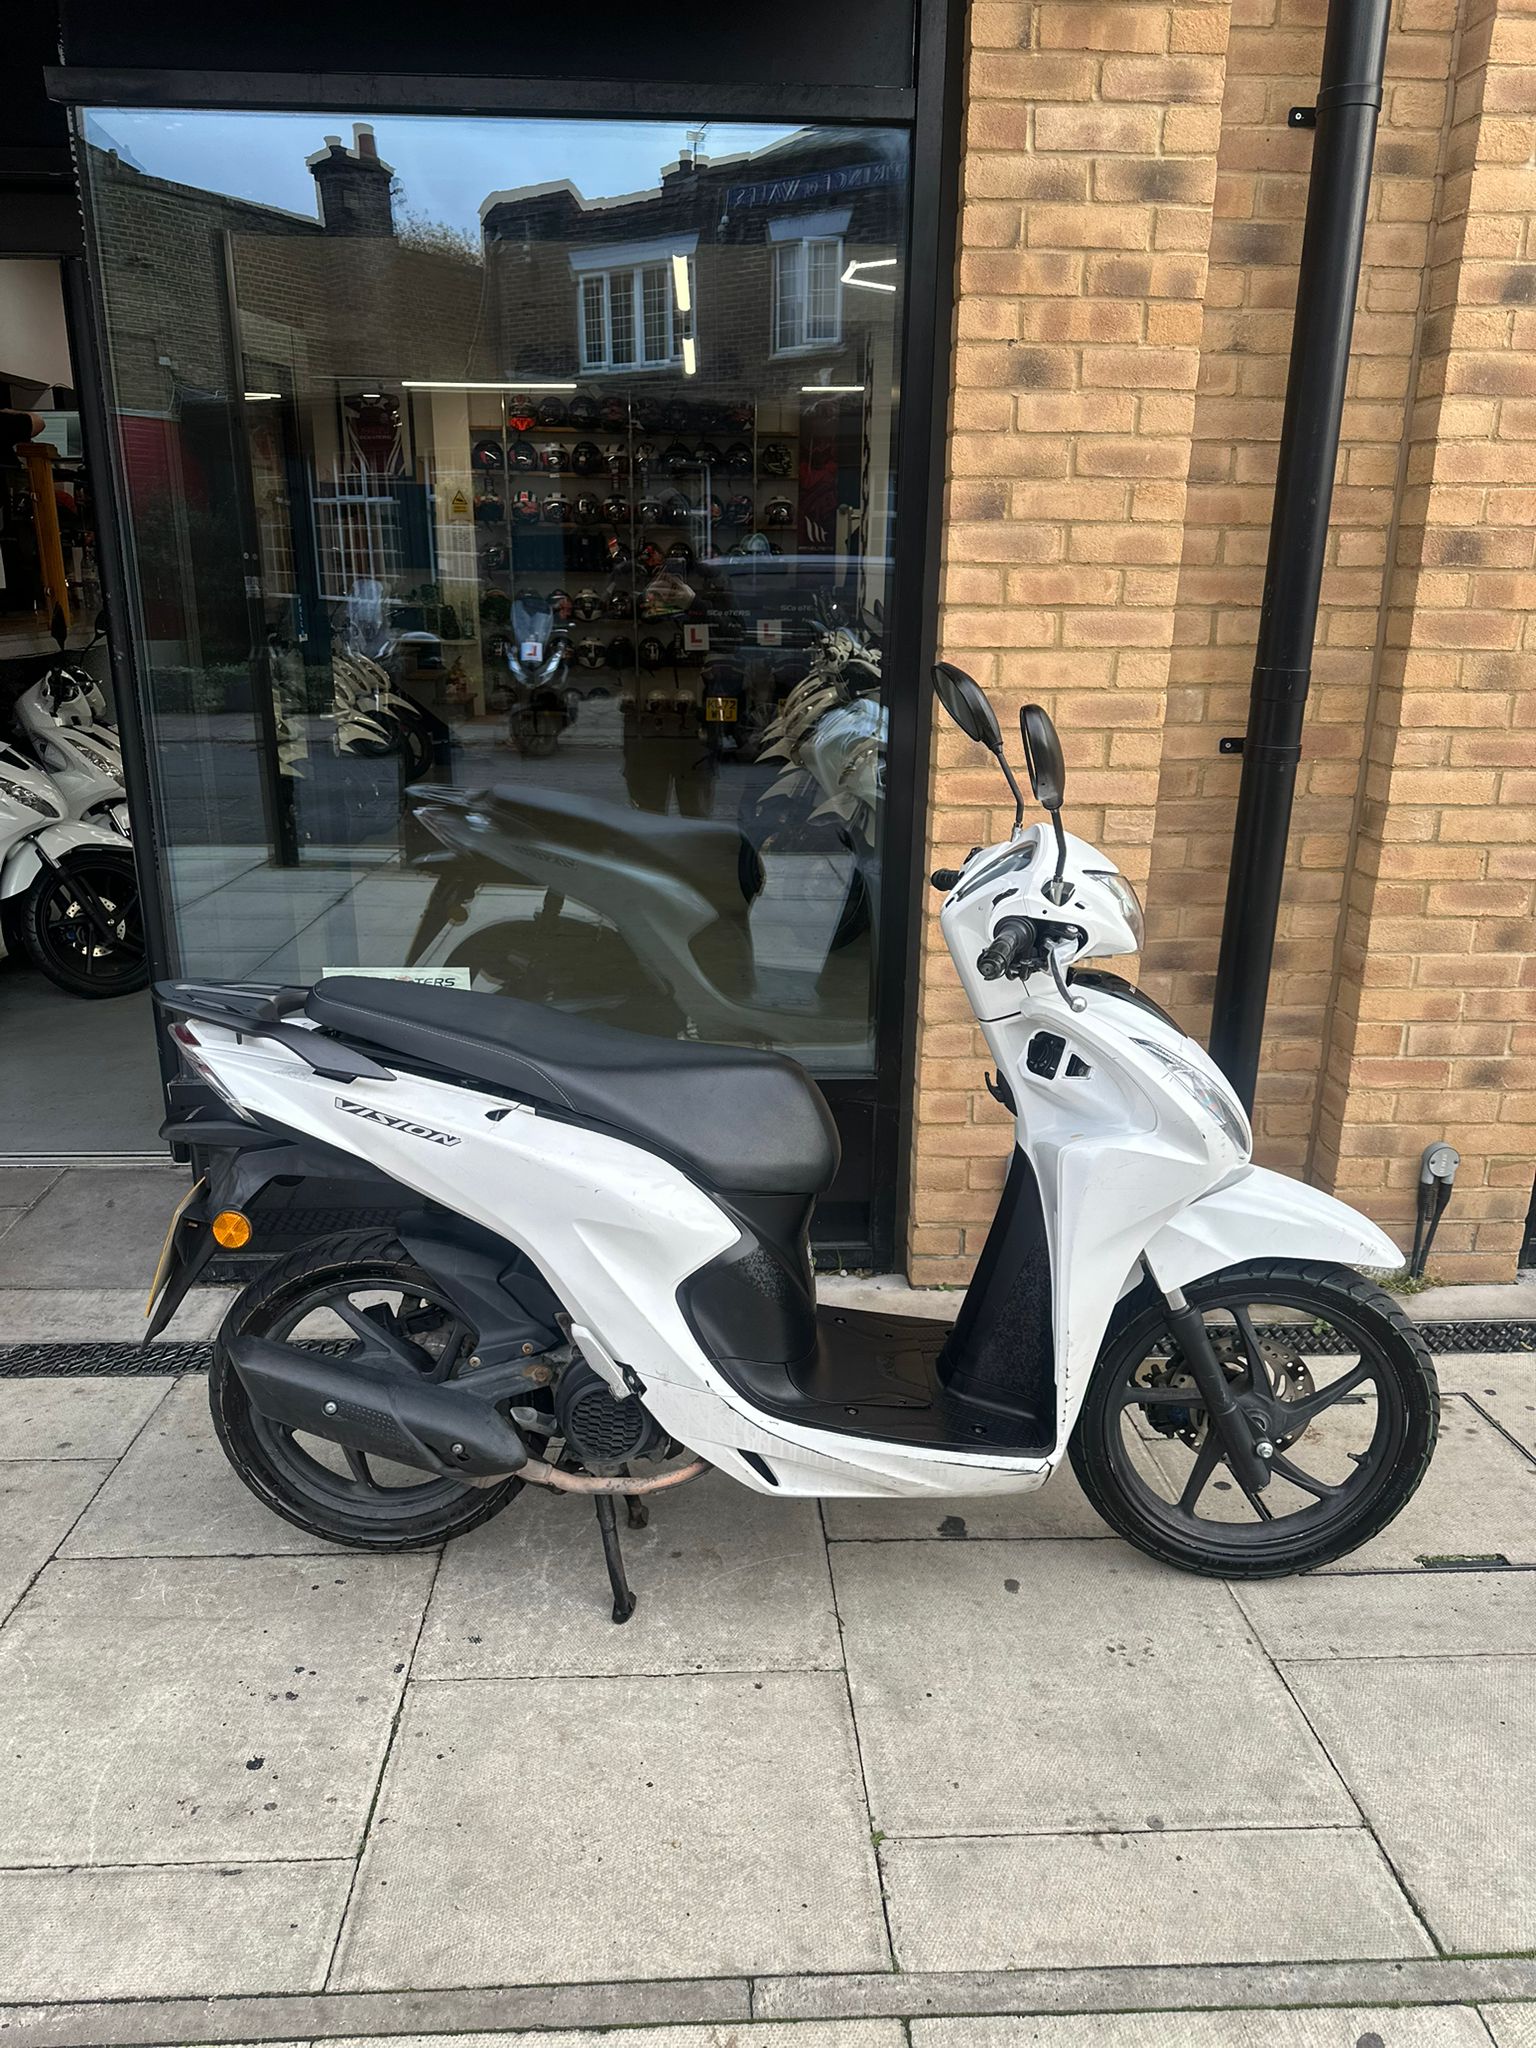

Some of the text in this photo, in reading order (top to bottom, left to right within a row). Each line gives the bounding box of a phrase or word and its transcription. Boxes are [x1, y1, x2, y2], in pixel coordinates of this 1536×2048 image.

[690, 628, 703, 644] L
[414, 977, 456, 987] TERS
[335, 1097, 462, 1147] VISION
